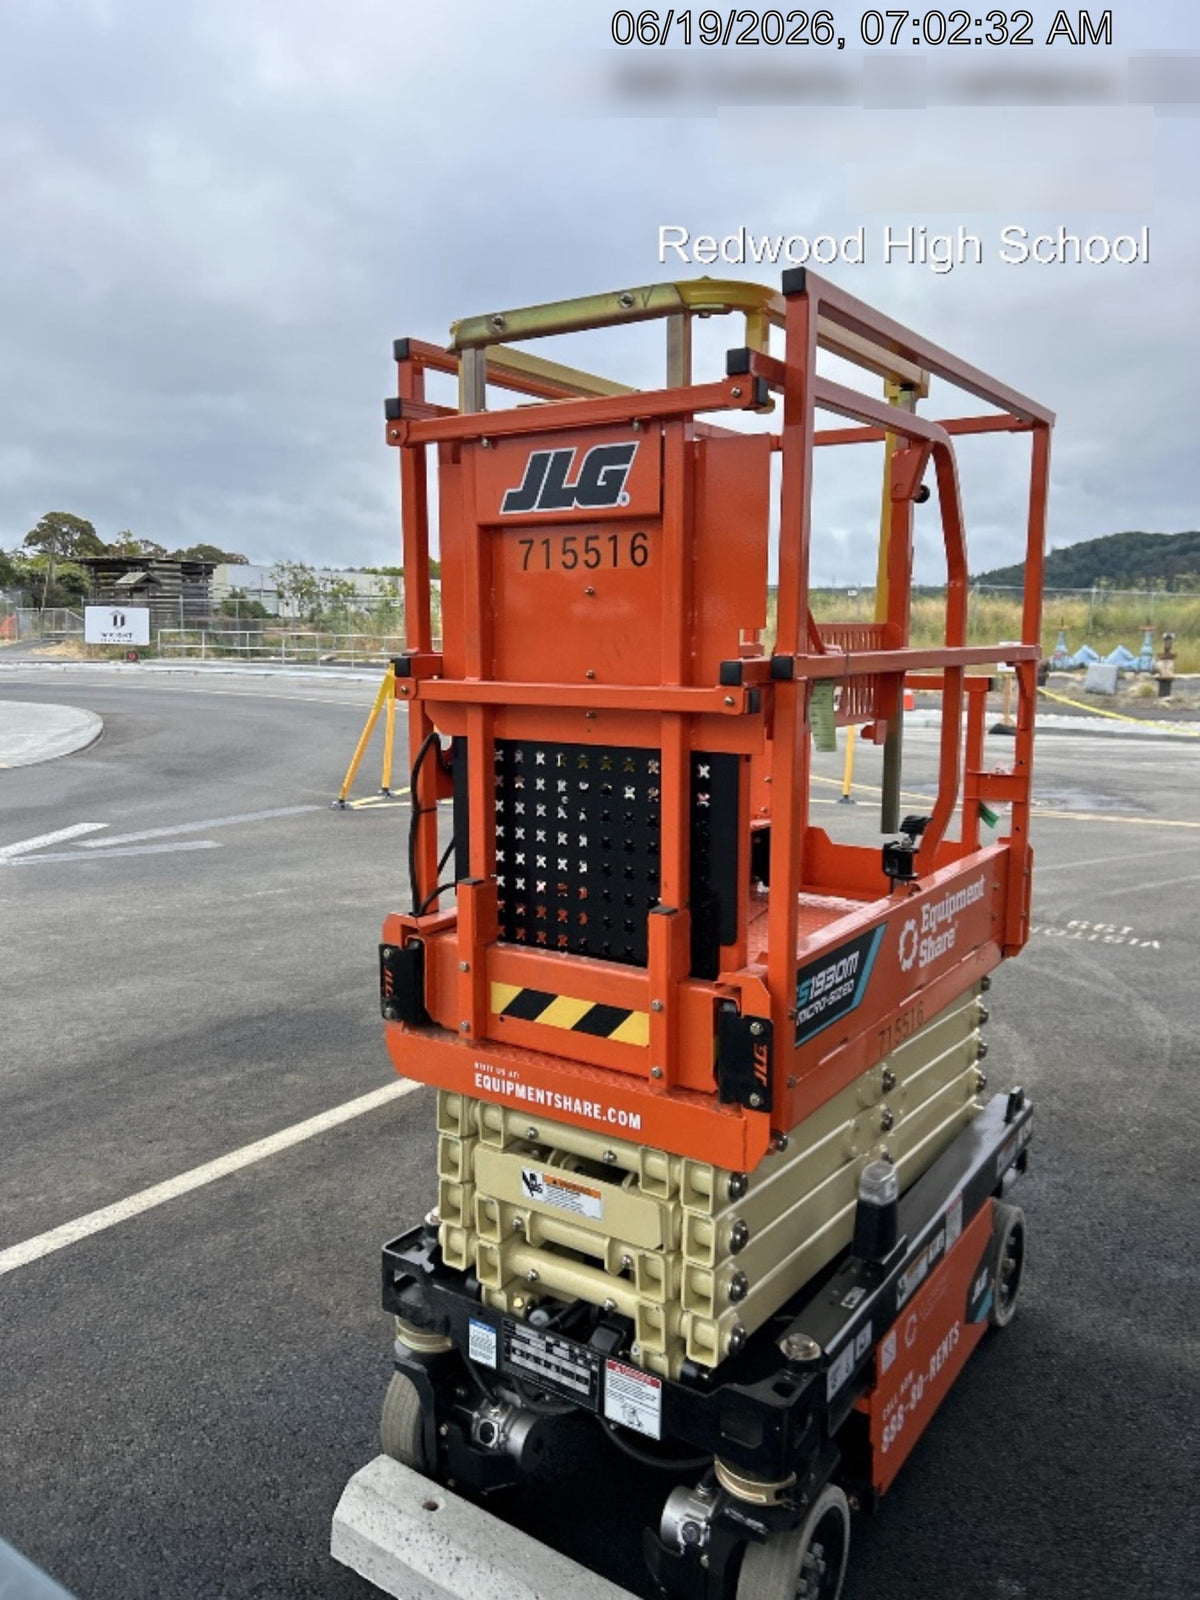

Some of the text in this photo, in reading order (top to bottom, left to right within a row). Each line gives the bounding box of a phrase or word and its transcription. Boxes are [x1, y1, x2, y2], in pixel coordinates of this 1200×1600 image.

[500, 441, 640, 514] JLG
[518, 532, 649, 571] 715516
[920, 873, 985, 933] Equipment
[919, 928, 956, 968] Share
[878, 1000, 924, 1057] 715516
[753, 1042, 768, 1087] JLG
[475, 1073, 641, 1130] EQUIPMENTSHARE.COM
